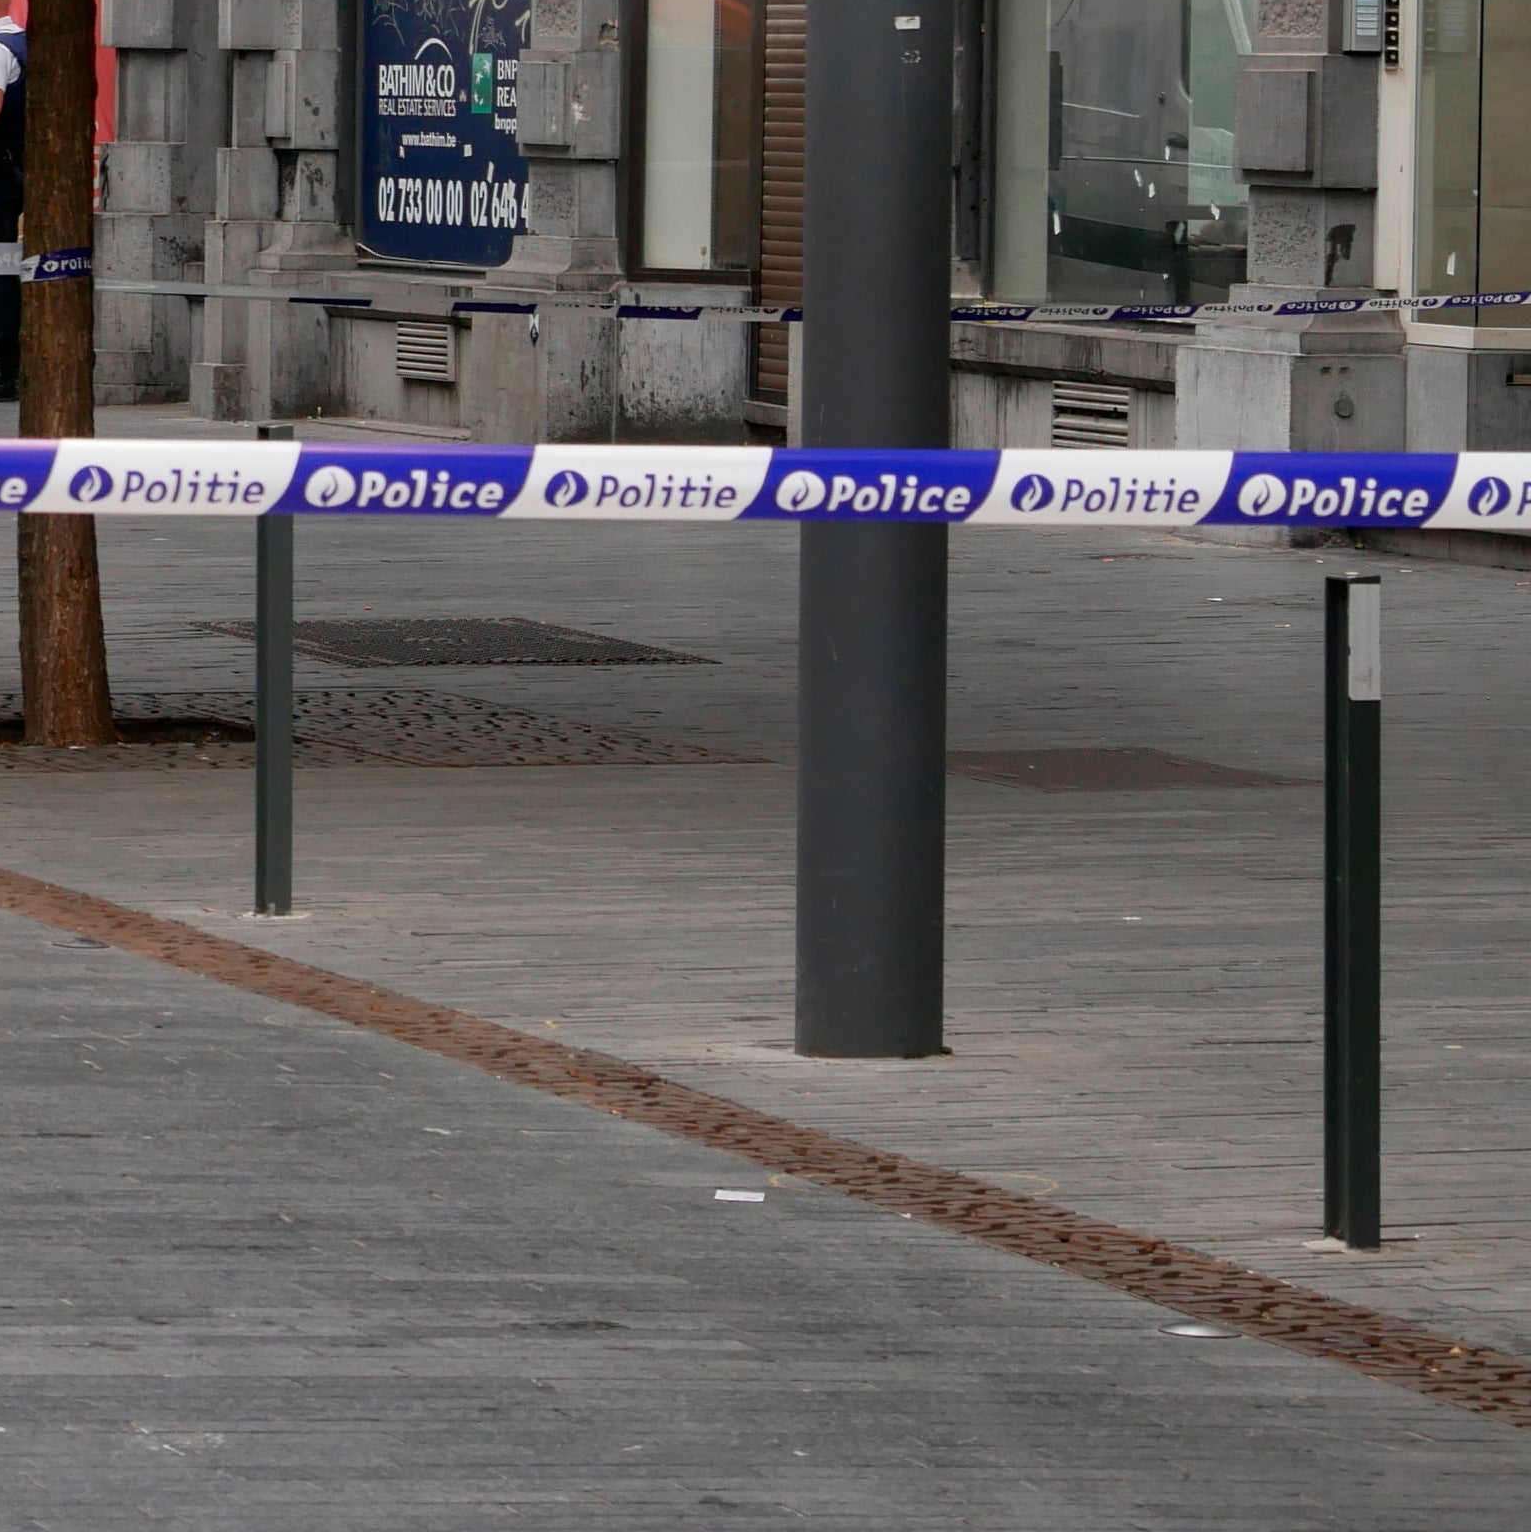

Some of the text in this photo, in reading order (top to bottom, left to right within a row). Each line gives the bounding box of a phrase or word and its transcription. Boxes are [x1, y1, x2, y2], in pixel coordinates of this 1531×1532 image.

[378, 64, 456, 98] BATHIM & CO
[497, 59, 518, 81] BNP
[378, 98, 457, 117] REAL ESTATE SERVICES
[401, 131, 457, 148] www.bathim.be
[378, 177, 464, 226] 02 733 00 00
[470, 180, 488, 227] 02
[121, 467, 265, 505] Politie
[355, 470, 505, 509] Police
[595, 474, 738, 510] Politie
[827, 474, 972, 514] Police
[1060, 478, 1201, 514] Politie
[1286, 478, 1429, 518] Police
